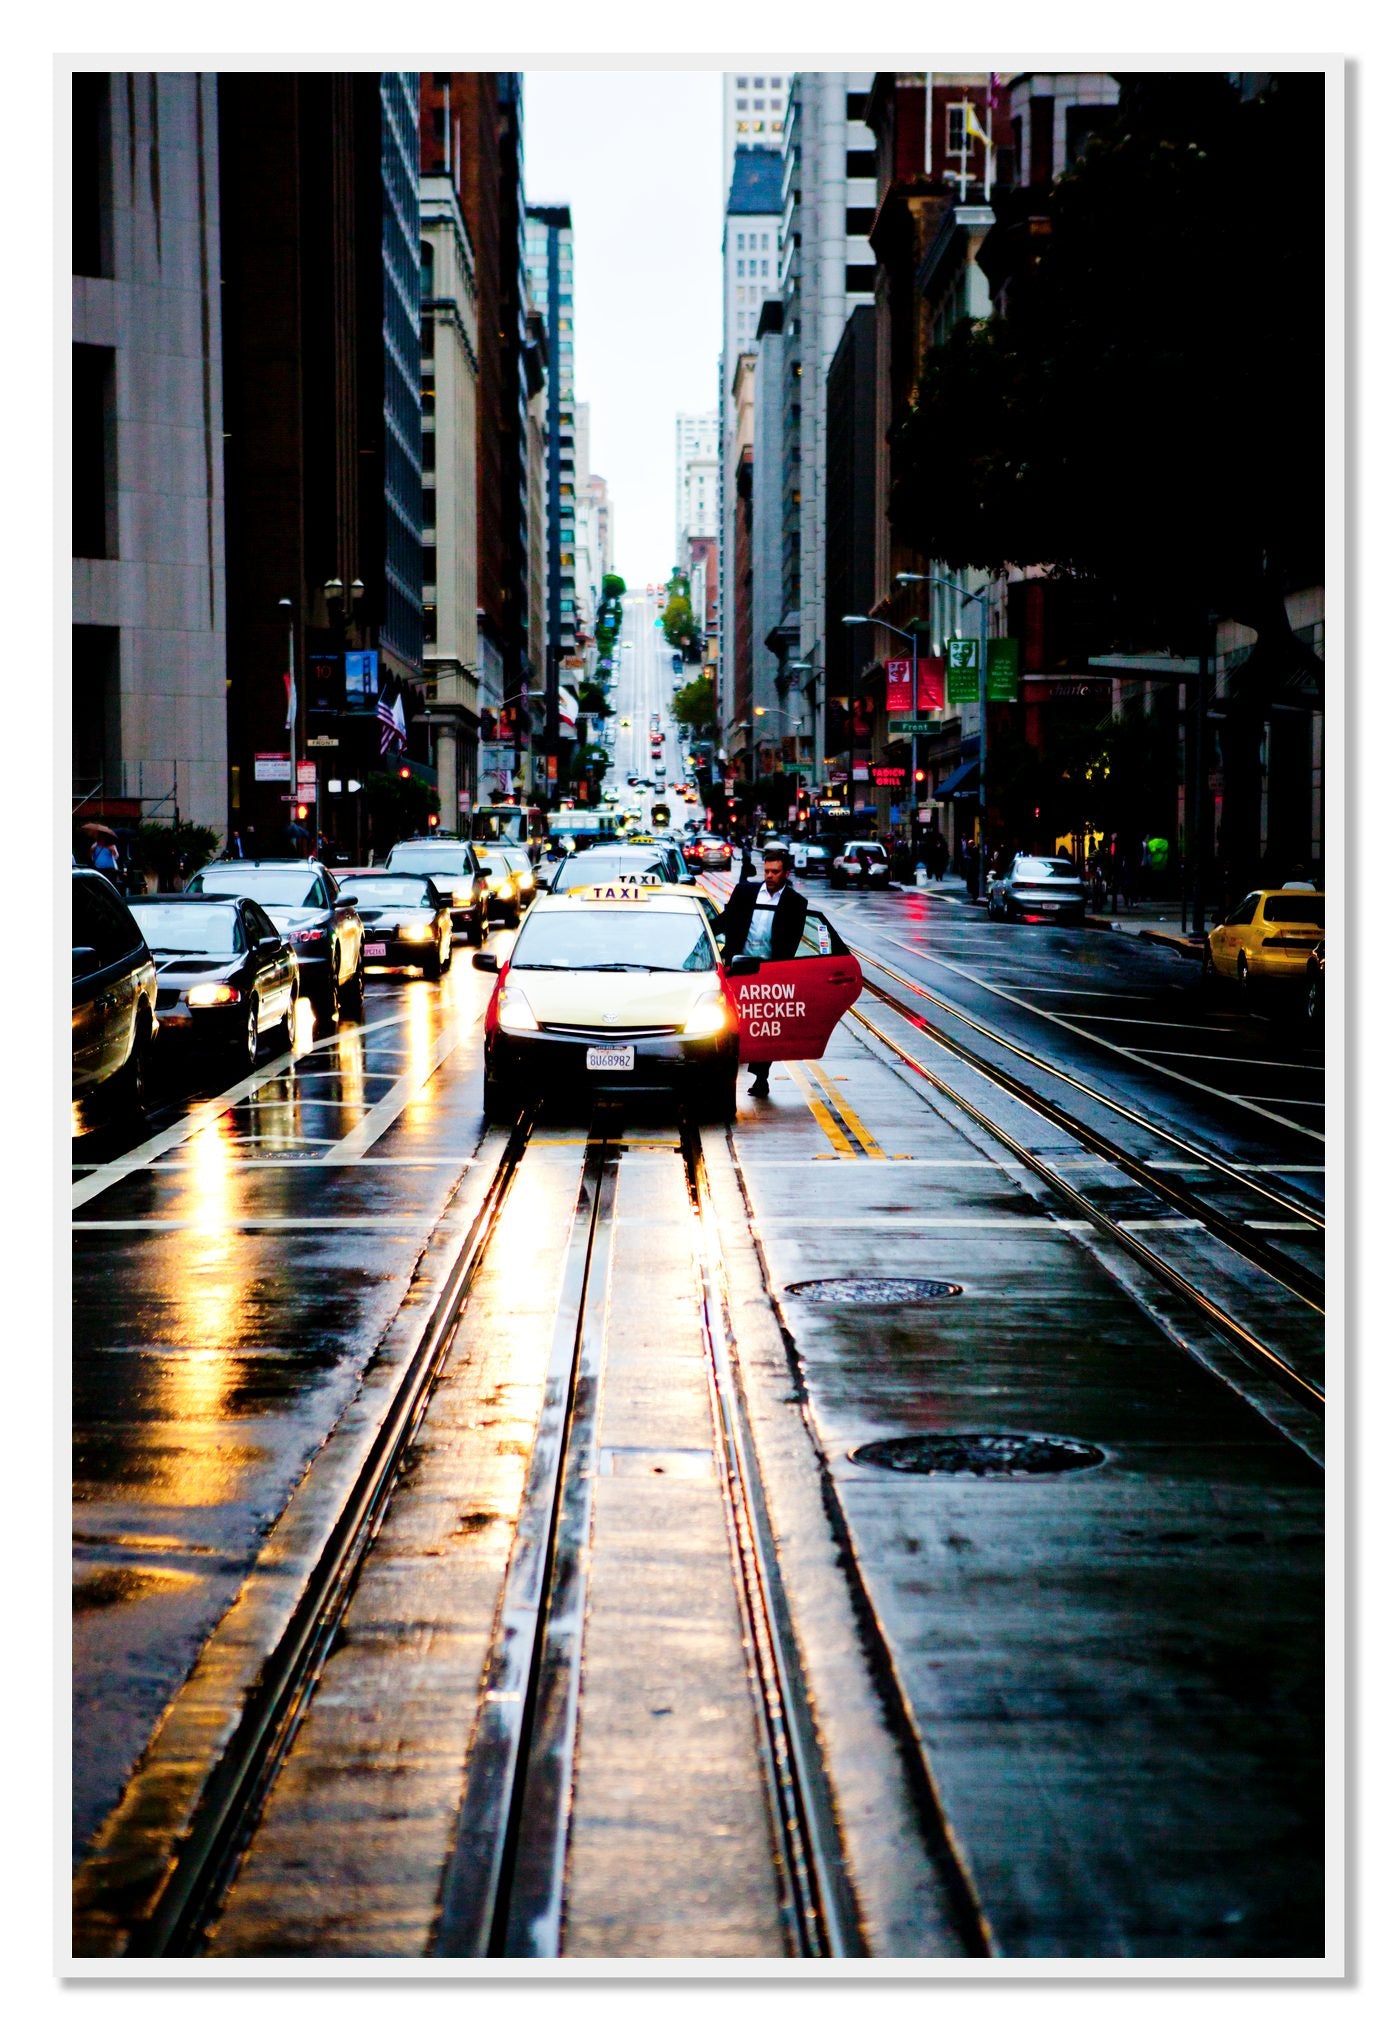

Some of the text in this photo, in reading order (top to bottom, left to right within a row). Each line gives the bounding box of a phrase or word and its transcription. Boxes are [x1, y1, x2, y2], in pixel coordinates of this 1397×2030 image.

[902, 723, 928, 731] Front
[872, 768, 906, 777] TADICH
[876, 777, 901, 786] GRILL
[619, 875, 655, 884] TAXI
[593, 888, 639, 899] TAXI
[739, 983, 795, 1000] ARROW
[749, 1021, 781, 1037] CAB
[590, 1055, 631, 1067] 8U68982
